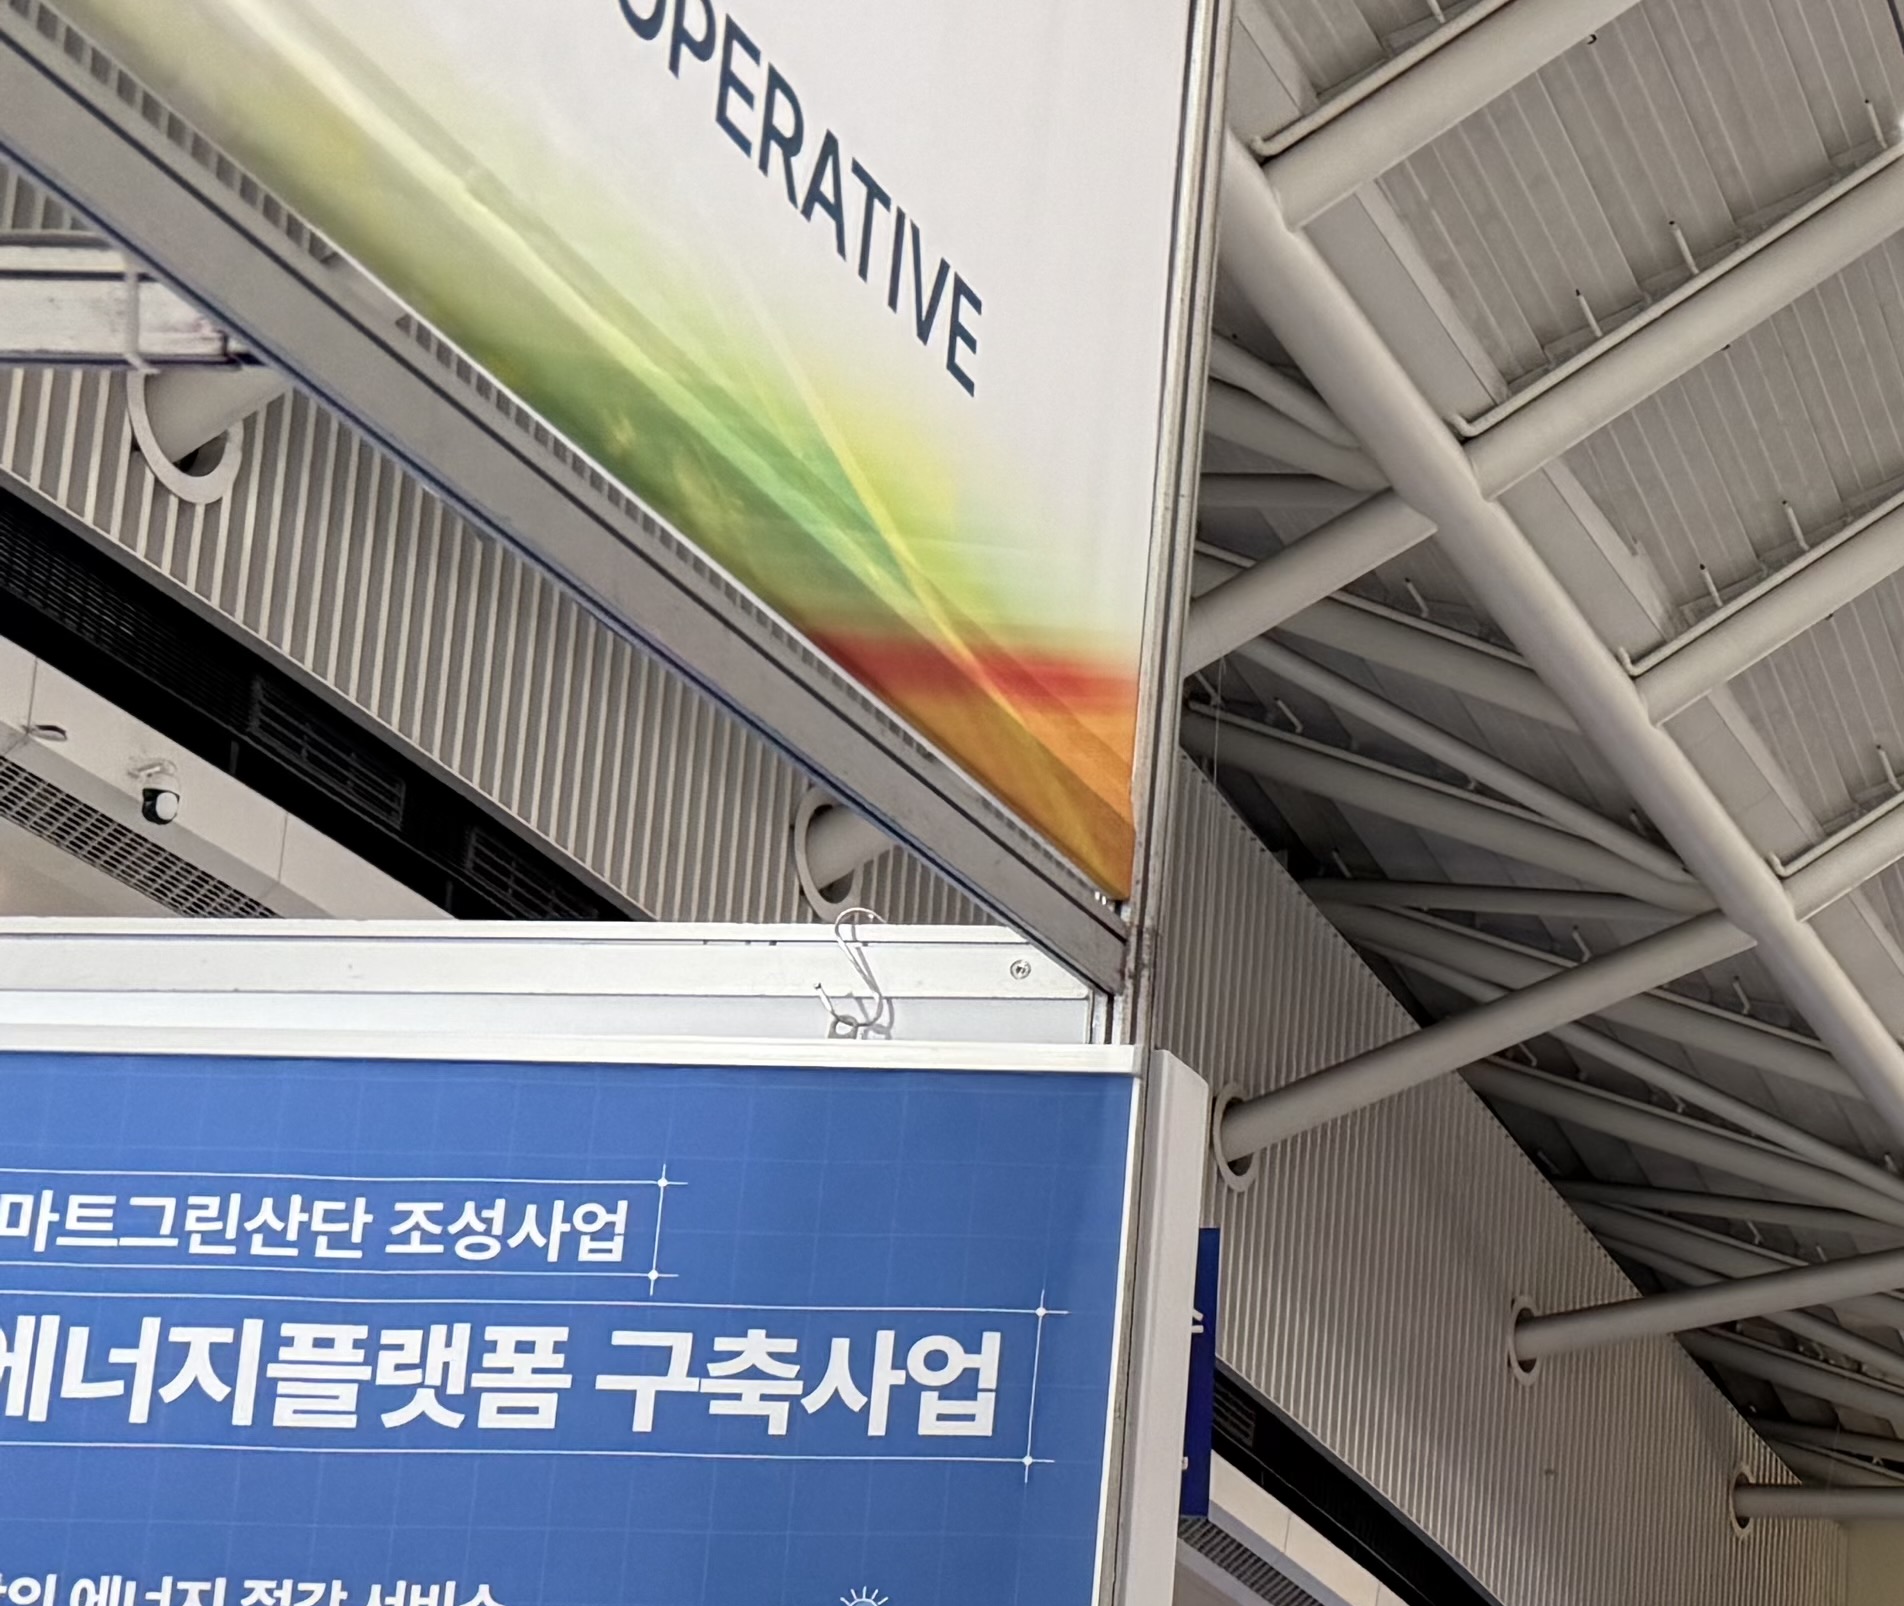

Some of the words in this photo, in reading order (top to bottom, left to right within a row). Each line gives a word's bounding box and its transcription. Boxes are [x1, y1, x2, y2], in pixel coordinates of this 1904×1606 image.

[0, 1192, 372, 1261] 마트그린산단
[384, 1199, 629, 1264] 조성사업
[595, 1328, 1001, 1437] 구축사업
